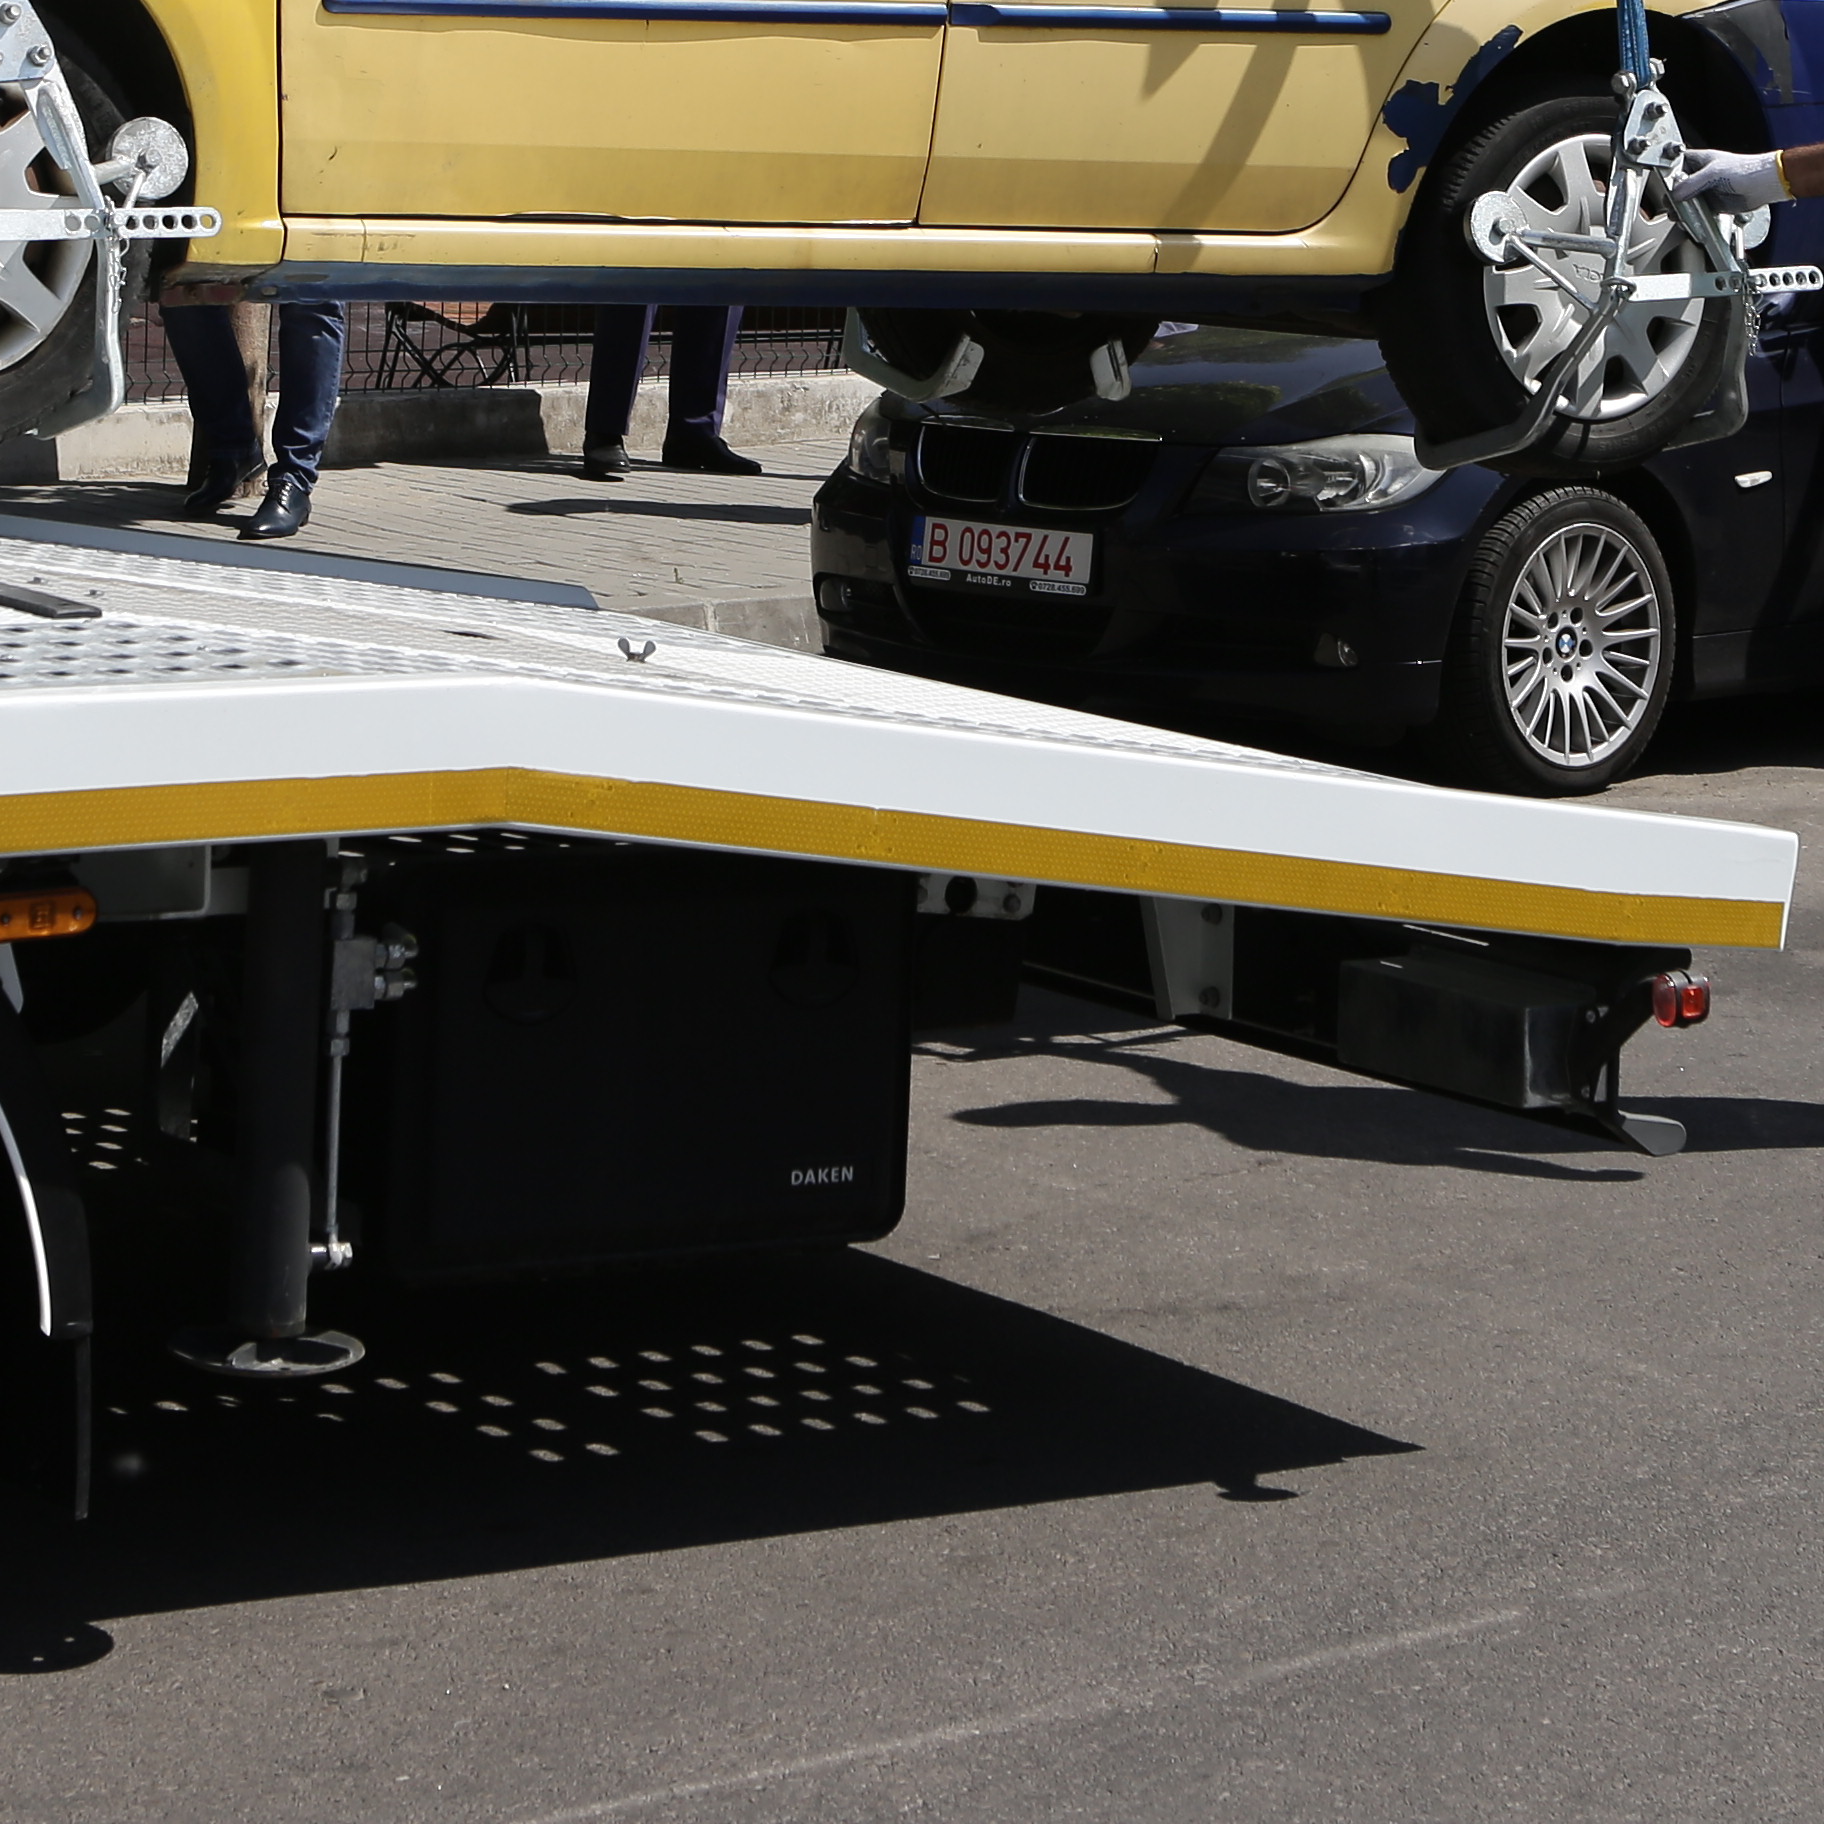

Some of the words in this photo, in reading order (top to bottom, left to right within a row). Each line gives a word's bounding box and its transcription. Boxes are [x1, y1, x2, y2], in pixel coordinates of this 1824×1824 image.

[928, 523, 949, 564] B
[958, 526, 1073, 578] 093744
[966, 573, 1012, 587] AutoDE.ro
[790, 1166, 854, 1186] DAKEN
